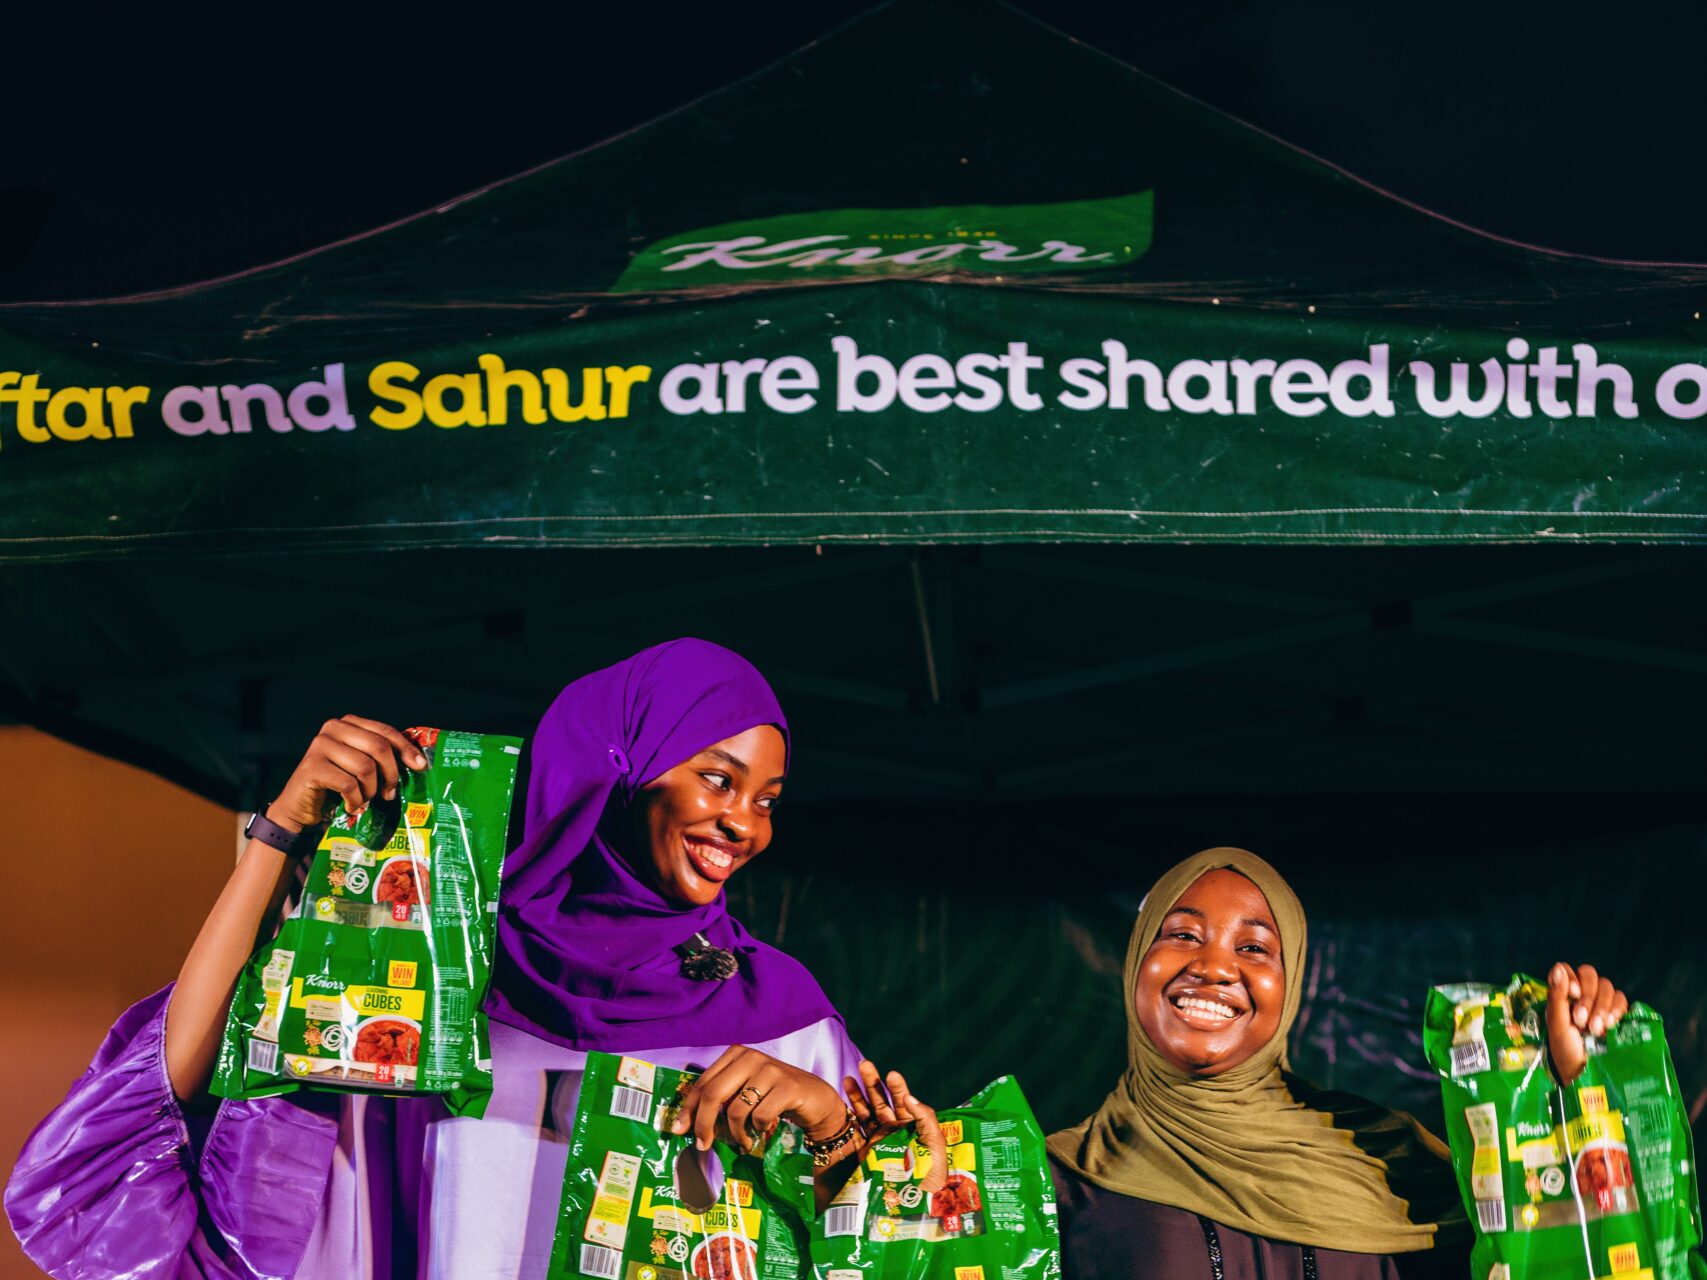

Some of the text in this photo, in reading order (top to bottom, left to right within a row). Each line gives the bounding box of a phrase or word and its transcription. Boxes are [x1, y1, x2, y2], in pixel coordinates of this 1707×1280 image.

[661, 235, 1114, 272] Knorr
[161, 362, 356, 436] and
[368, 353, 652, 430] Sahur
[659, 355, 820, 415] are
[831, 335, 1044, 413] best
[1057, 338, 1396, 418] shared
[1408, 337, 1639, 419] with
[386, 835, 413, 850] UBE
[392, 966, 414, 980] WIN
[305, 974, 346, 991] Knorr
[363, 993, 402, 1011] CUBES
[378, 1065, 390, 1075] 20
